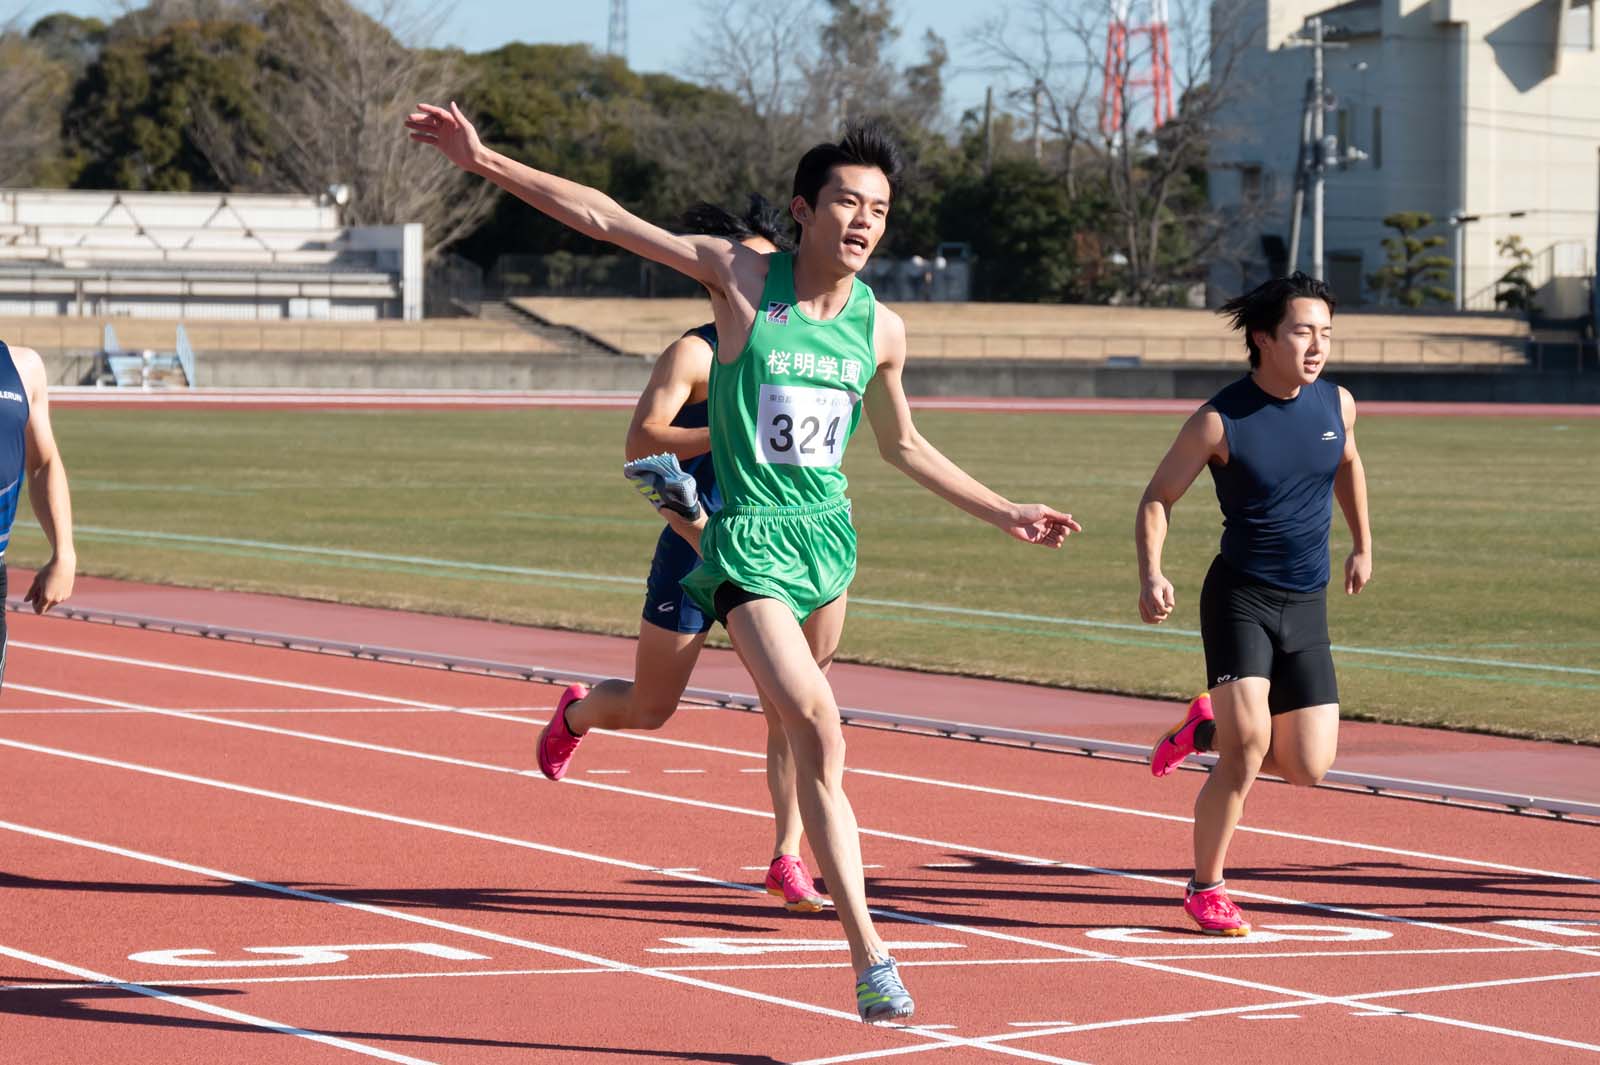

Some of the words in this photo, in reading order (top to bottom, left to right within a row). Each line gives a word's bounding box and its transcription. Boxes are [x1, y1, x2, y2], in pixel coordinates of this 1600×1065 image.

[767, 349, 861, 385] 桜明学園
[769, 413, 841, 455] 324
[127, 942, 493, 967] 5
